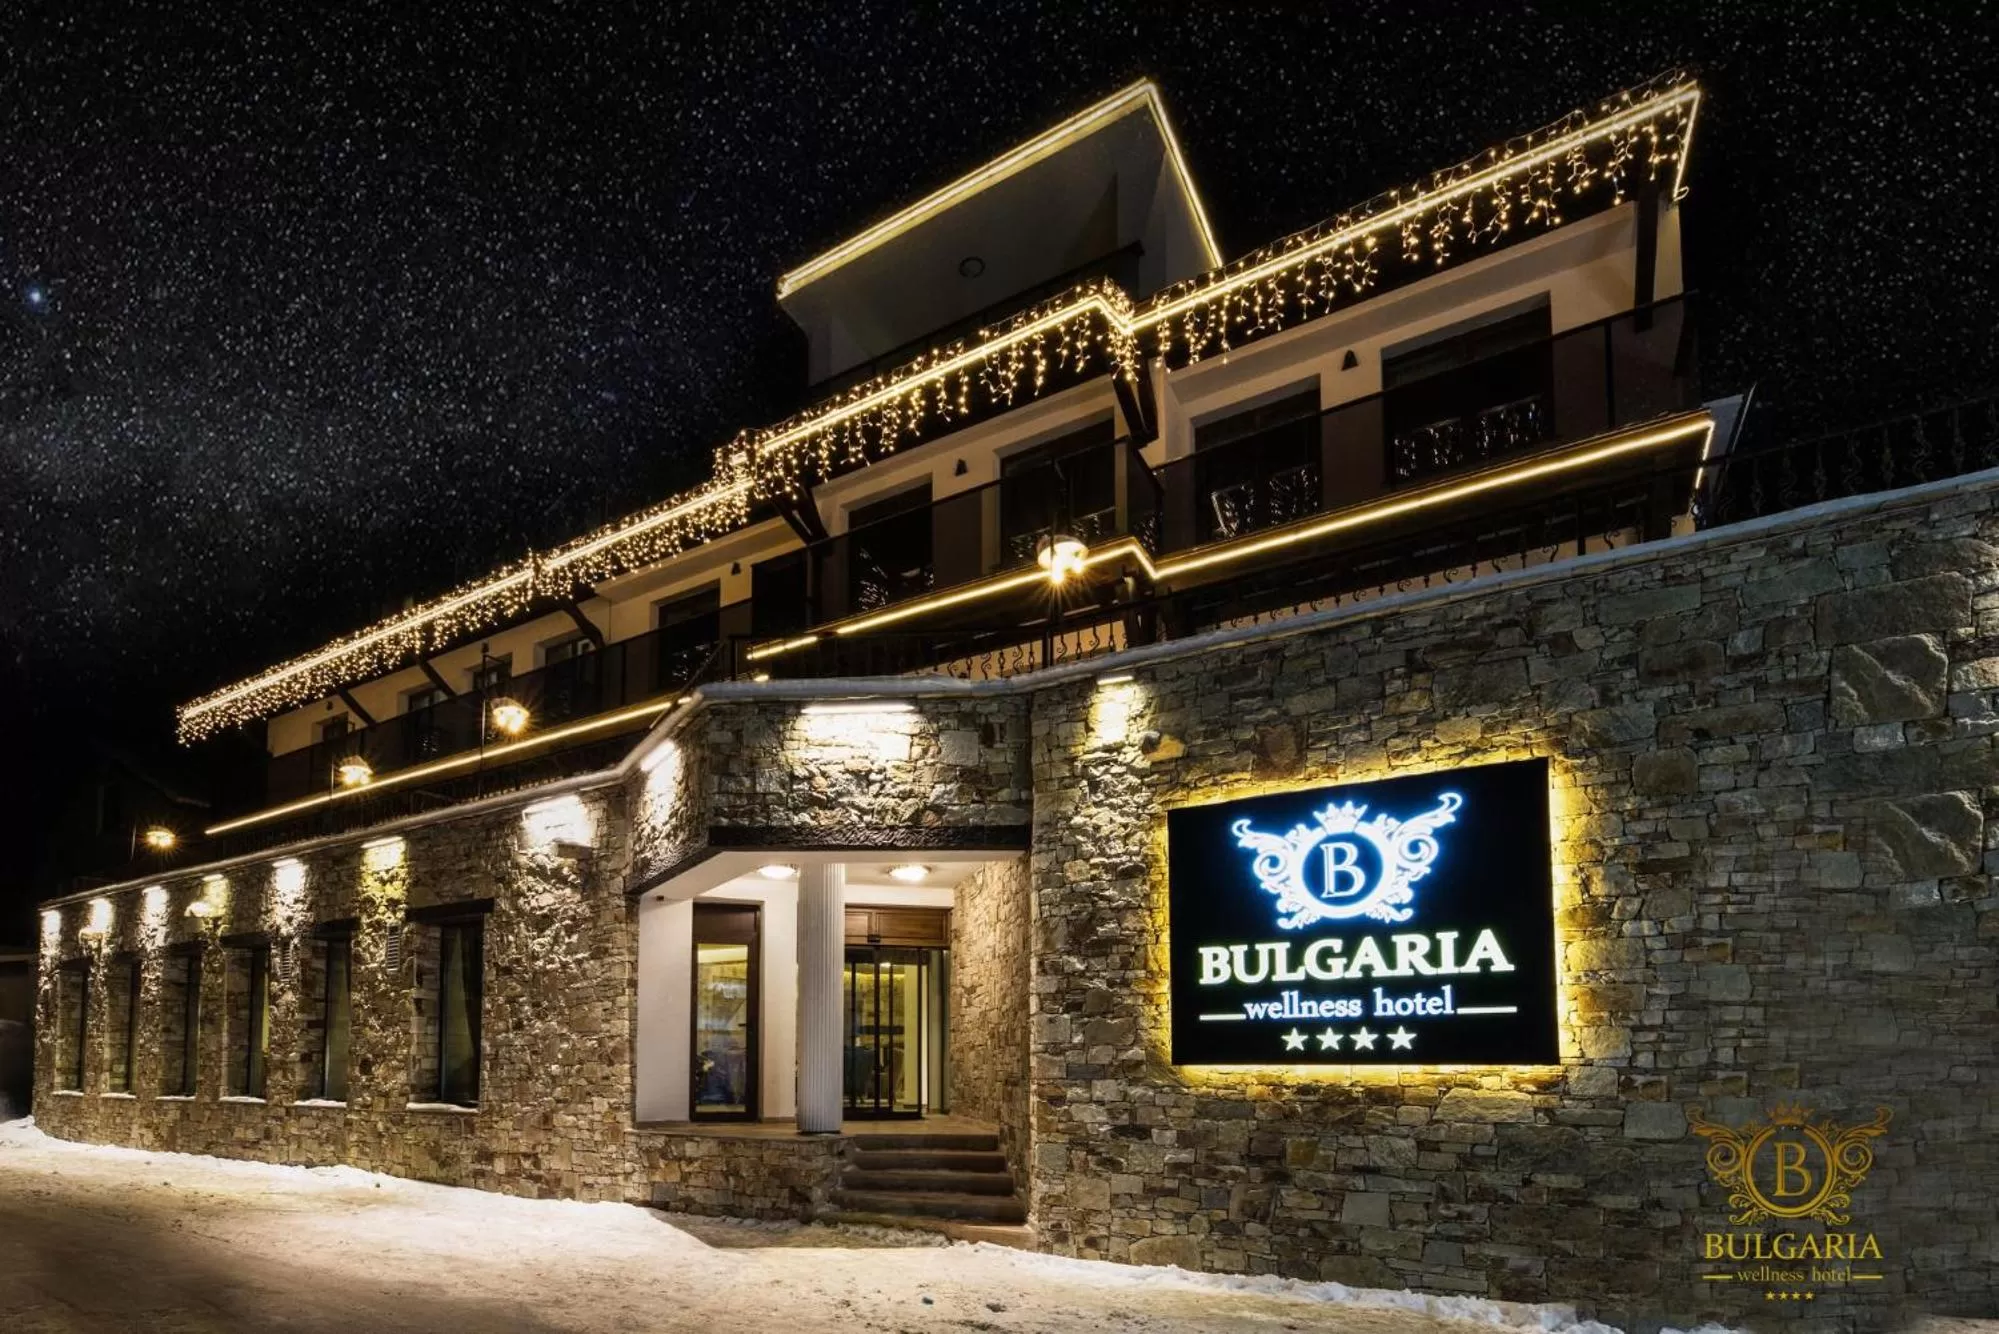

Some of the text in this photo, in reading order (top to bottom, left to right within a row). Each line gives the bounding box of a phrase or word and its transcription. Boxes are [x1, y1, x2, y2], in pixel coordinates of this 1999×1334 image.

[1319, 841, 1366, 899] B
[1198, 928, 1515, 985] BULGARIA
[1244, 984, 1454, 1021] wellness hotel
